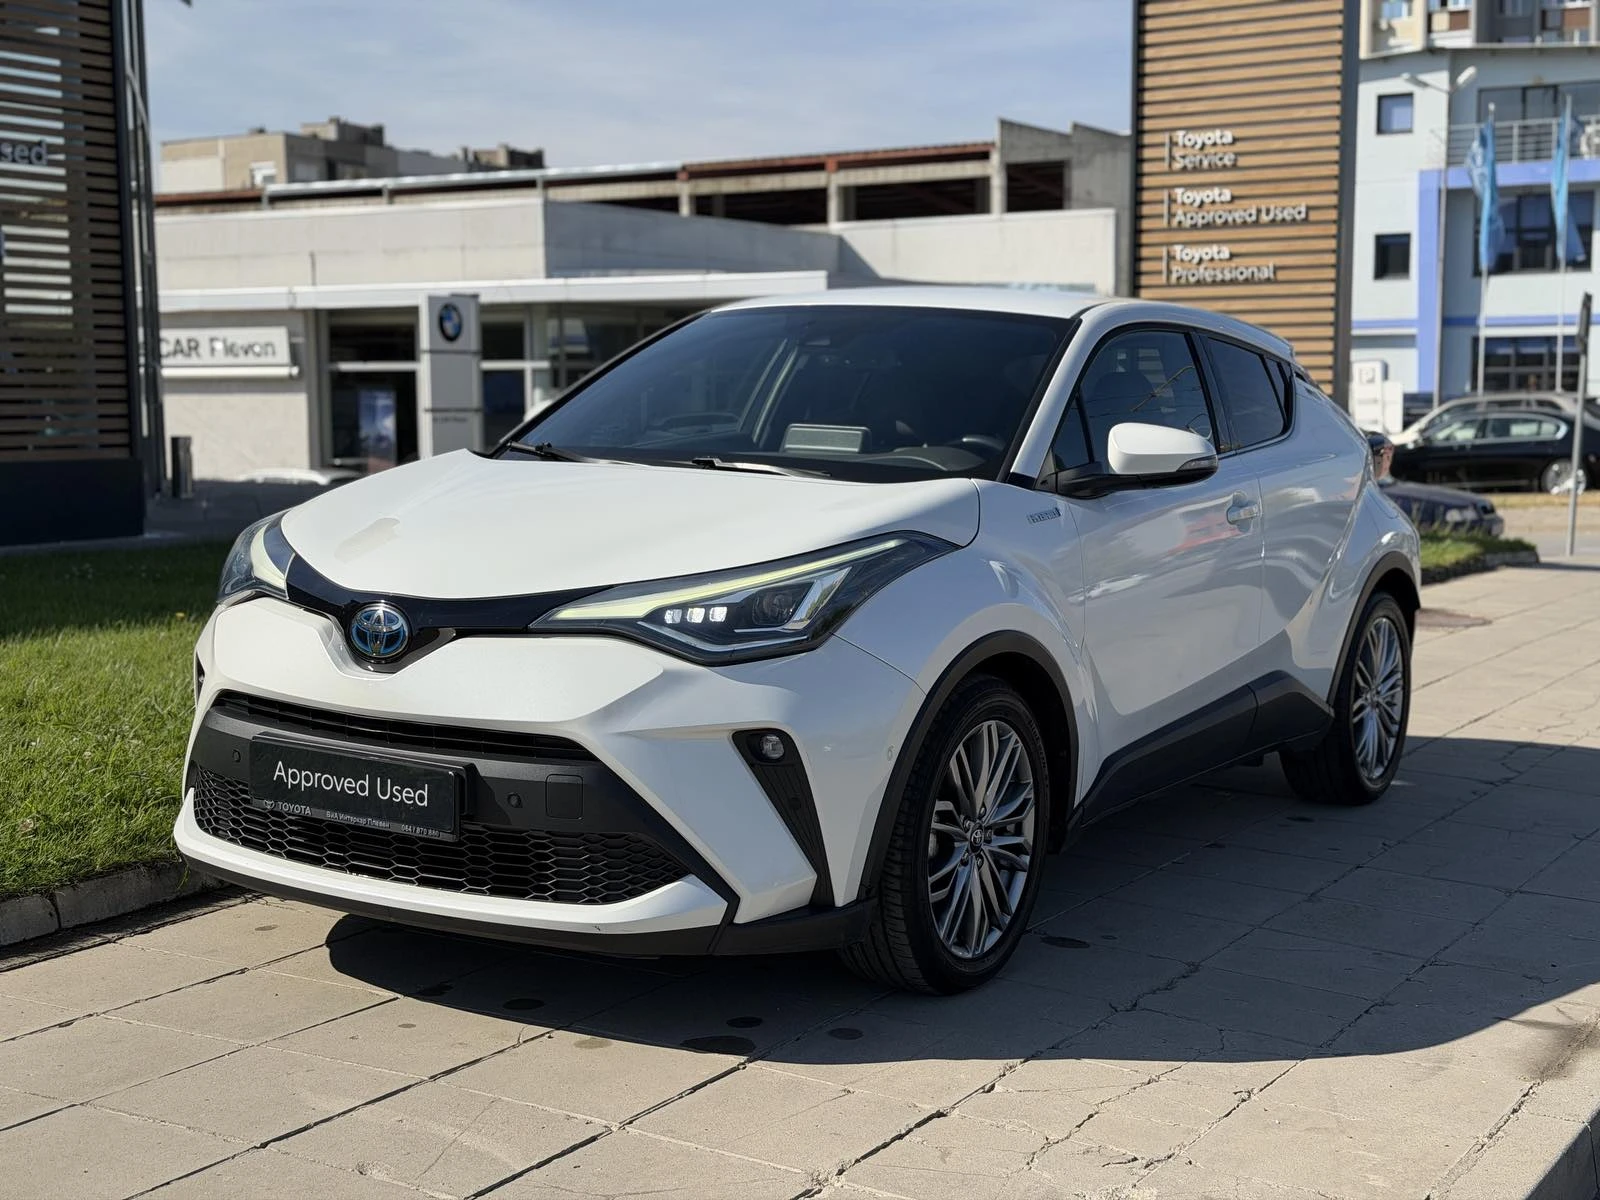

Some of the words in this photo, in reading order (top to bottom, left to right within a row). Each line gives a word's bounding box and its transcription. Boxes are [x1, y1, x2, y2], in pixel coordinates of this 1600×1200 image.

[1176, 129, 1233, 149] Toyota
[1174, 152, 1236, 169] Service
[1174, 187, 1232, 207] Toyota
[1174, 207, 1258, 227] Approved
[1261, 203, 1307, 221] Used
[1173, 244, 1230, 264] Toyota
[1170, 263, 1274, 284] Professional
[273, 760, 369, 797] Approved
[377, 776, 428, 807] Used
[277, 801, 312, 816] TOYOTA
